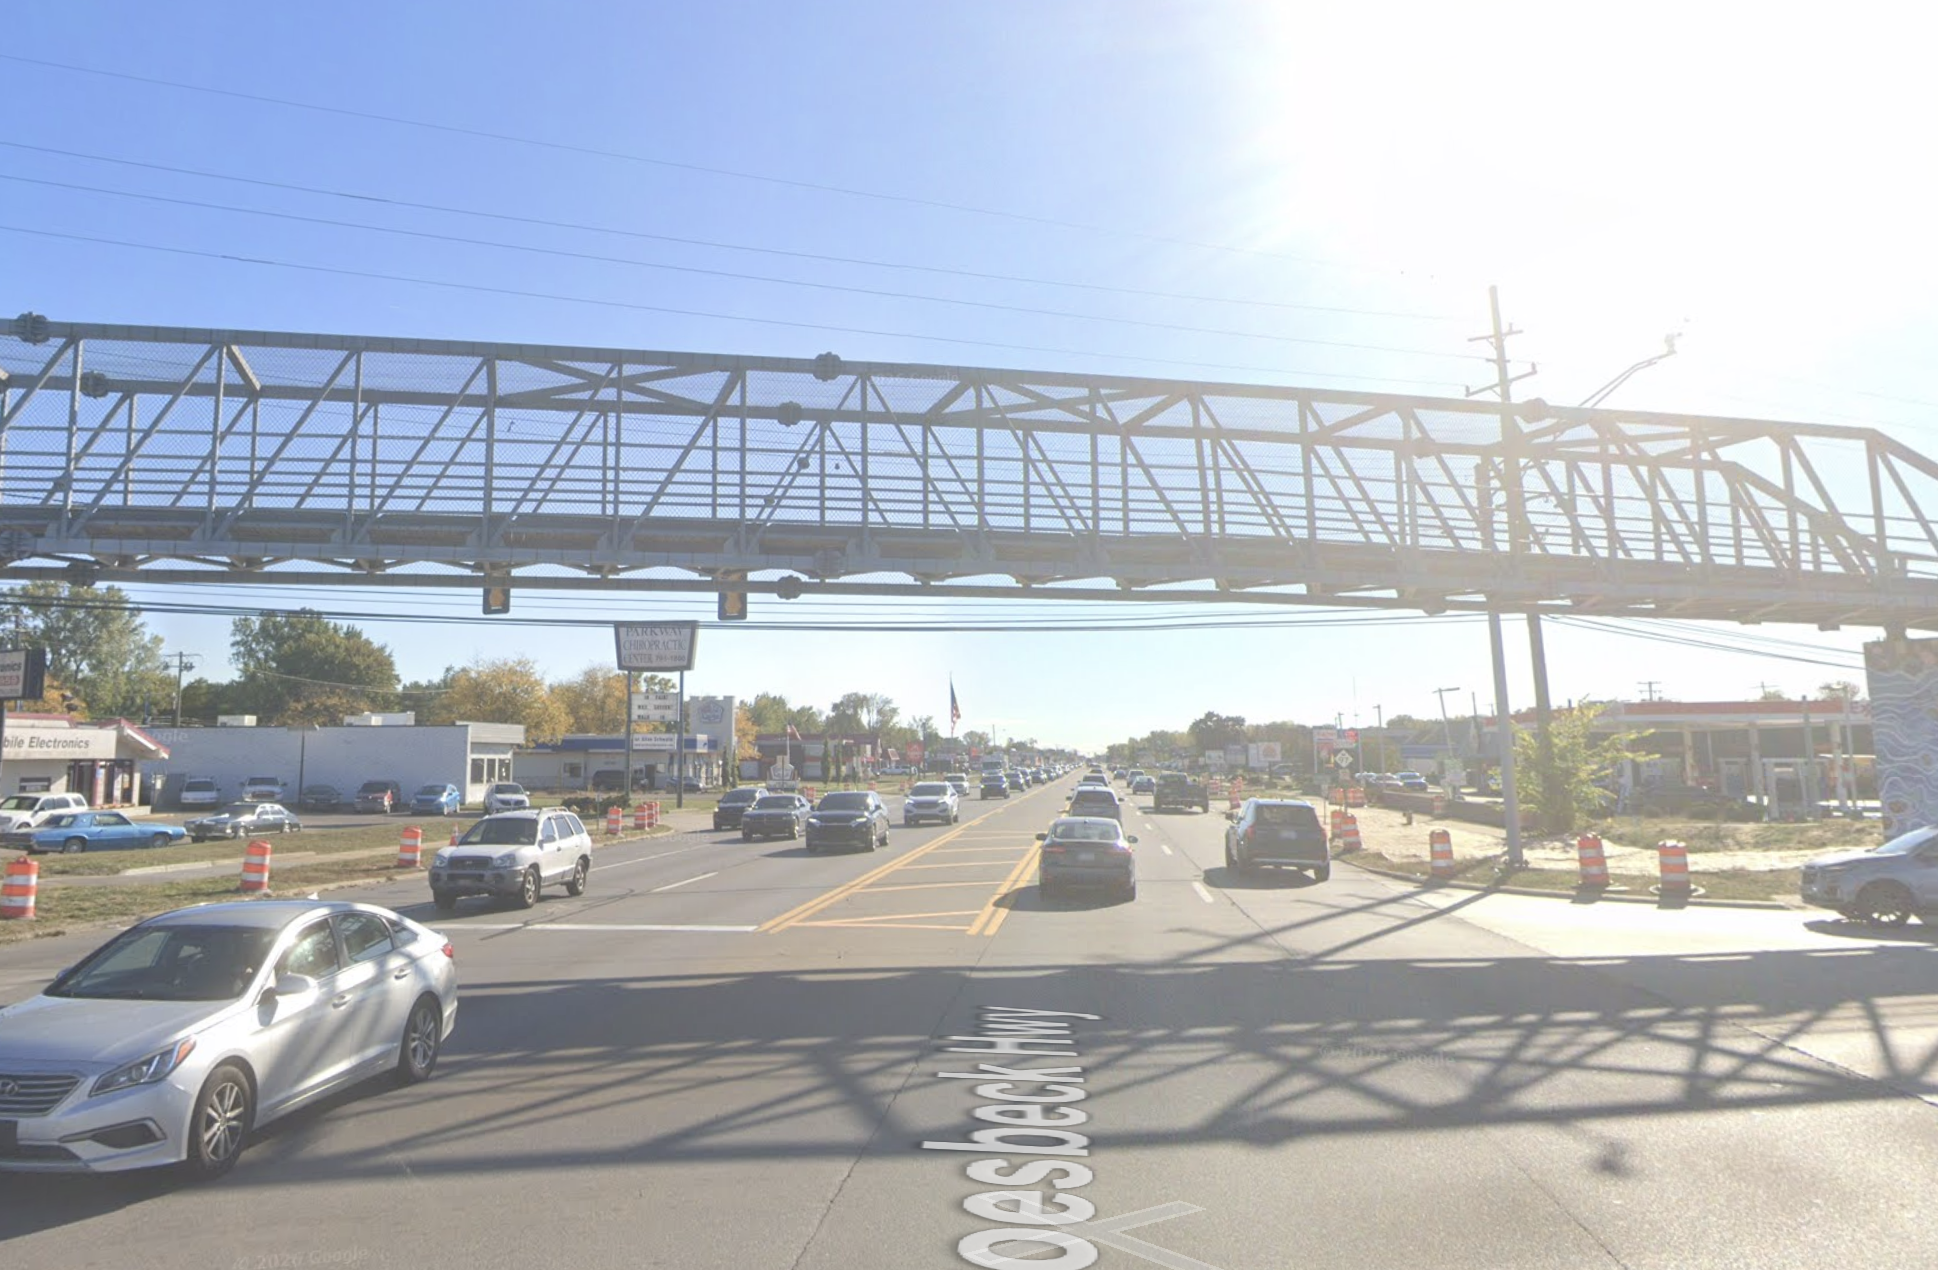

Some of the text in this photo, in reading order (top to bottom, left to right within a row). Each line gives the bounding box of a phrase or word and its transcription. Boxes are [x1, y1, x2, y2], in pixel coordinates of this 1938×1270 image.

[626, 627, 682, 637] PARKWAY
[623, 640, 687, 651] CHIROPRACTIC
[623, 654, 653, 664] CENTER
[28, 736, 90, 749] Electronics
